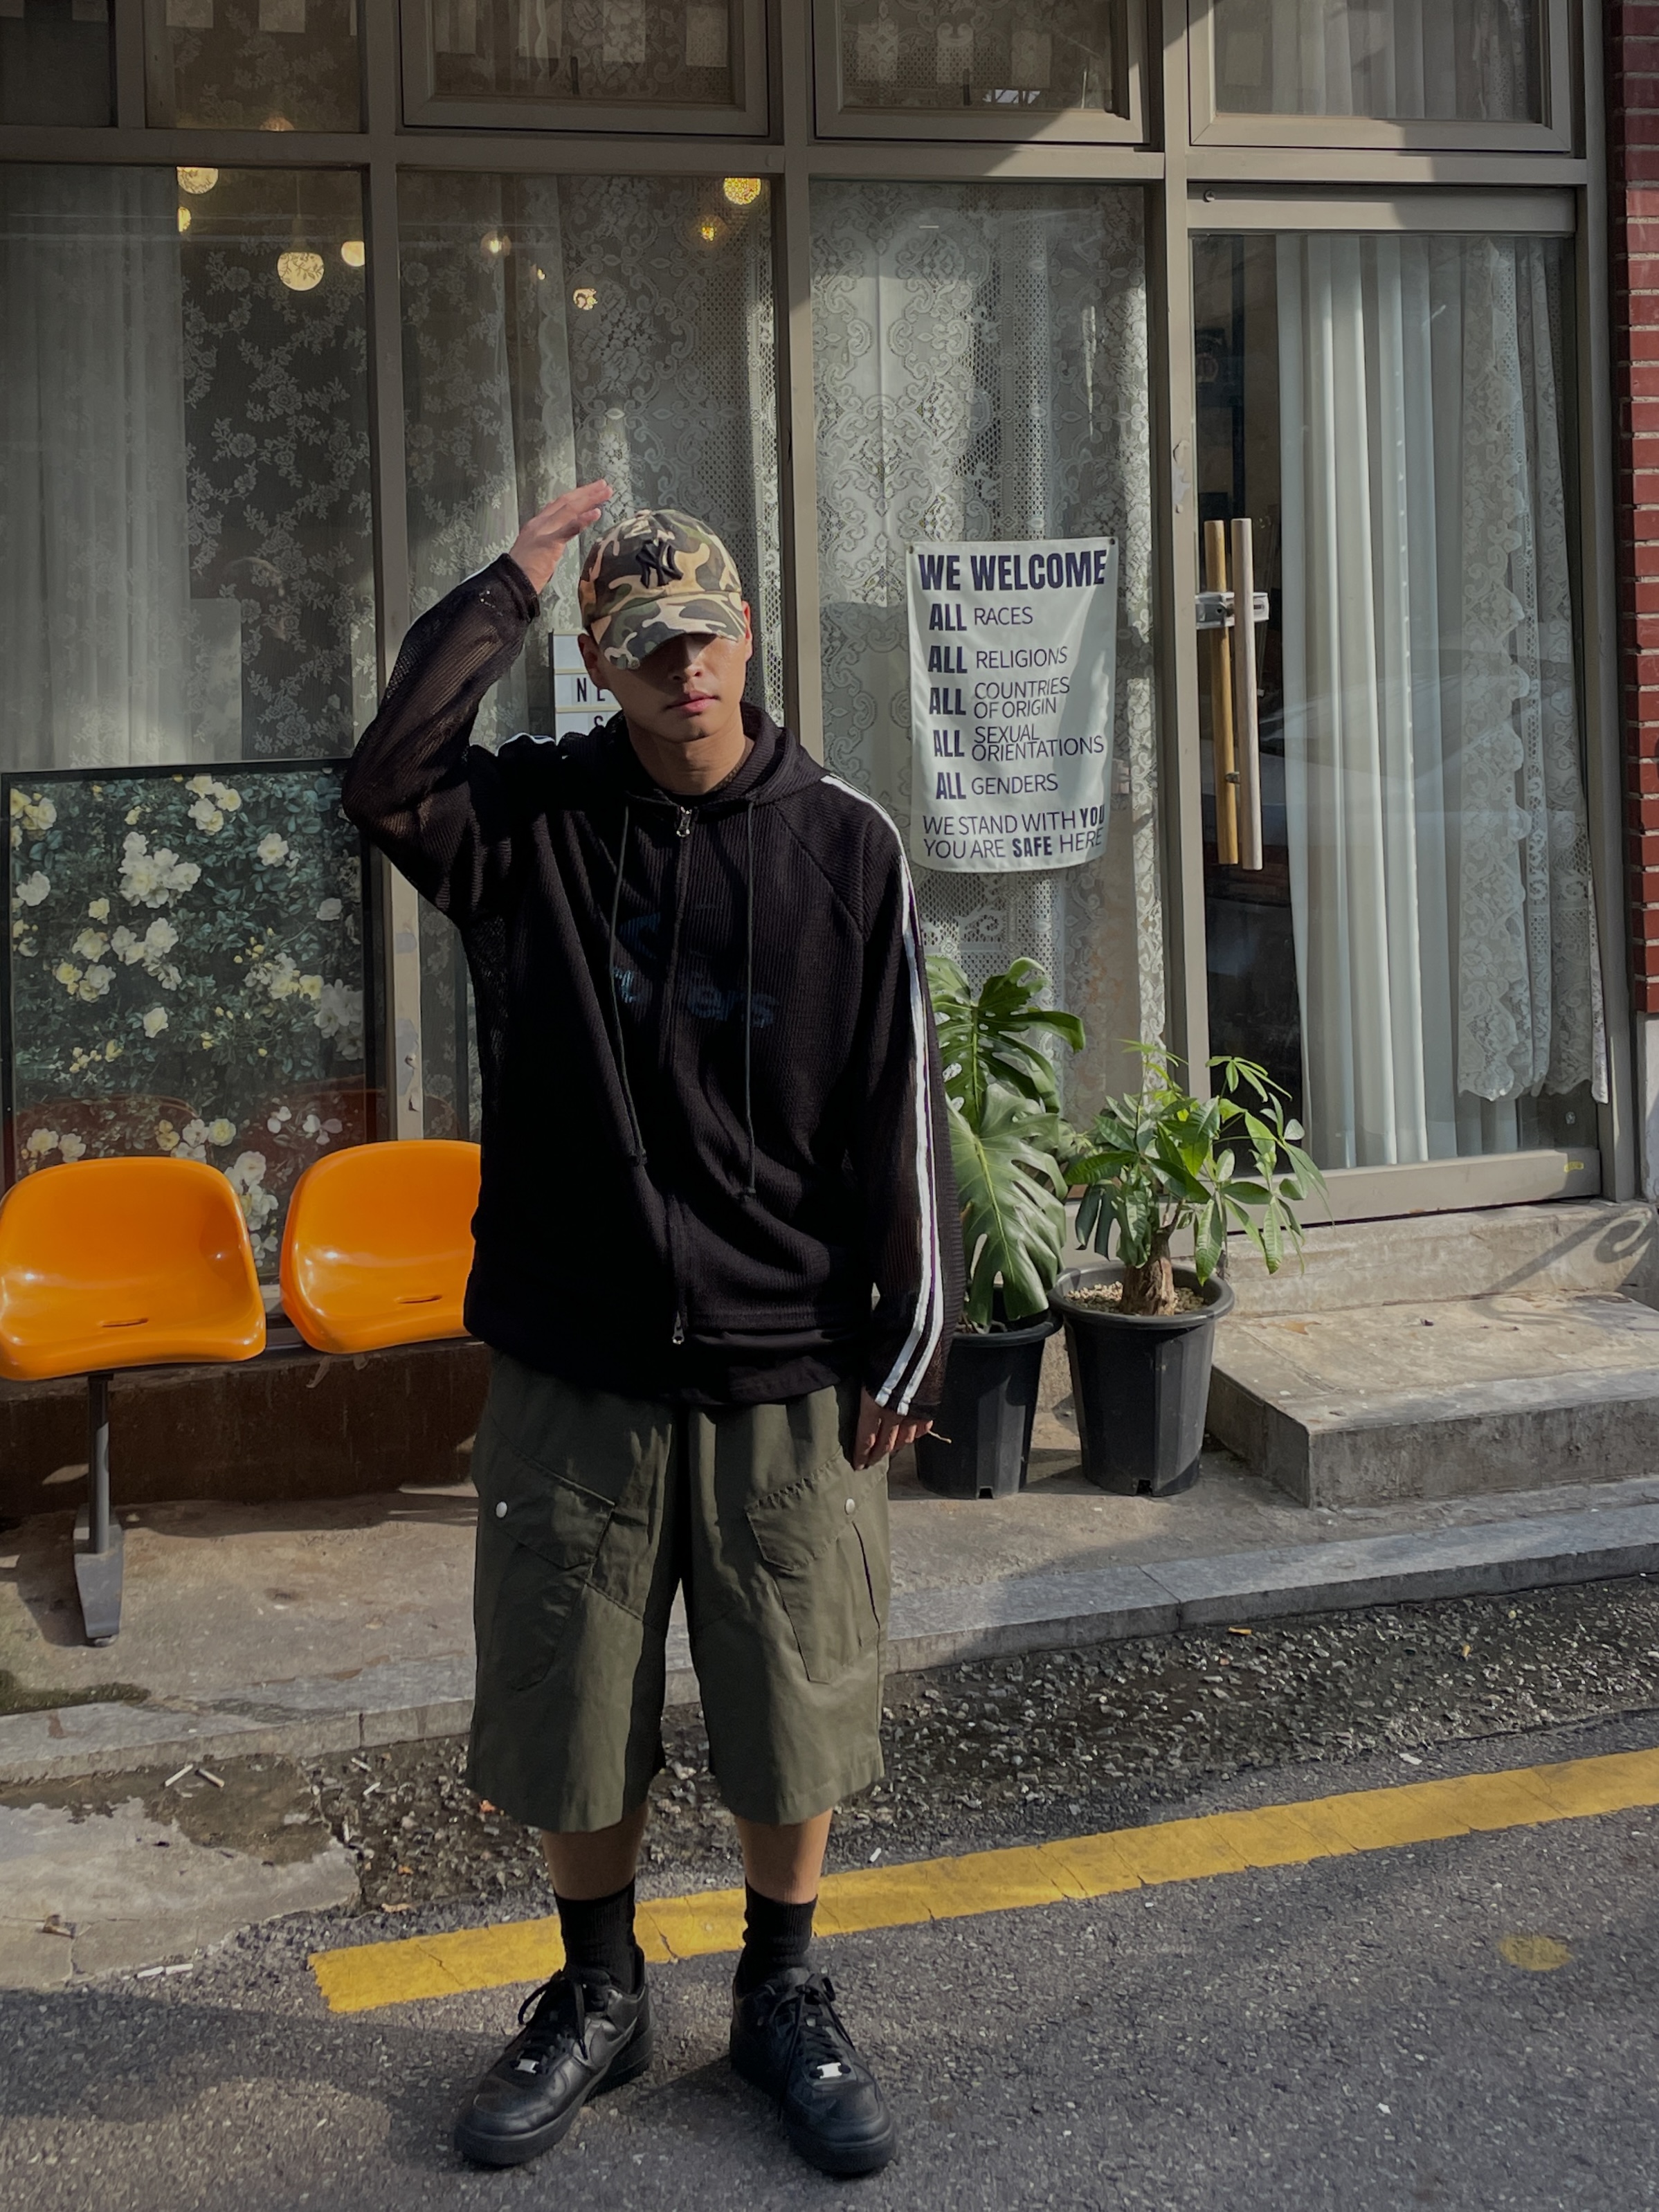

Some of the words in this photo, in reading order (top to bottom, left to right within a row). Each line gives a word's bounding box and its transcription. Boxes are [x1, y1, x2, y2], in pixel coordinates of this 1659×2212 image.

[635, 538, 684, 589] NY
[918, 554, 961, 590] WE
[970, 550, 1107, 591] WELCOME
[929, 604, 967, 631] ALL
[974, 606, 1033, 625] RACES
[928, 645, 968, 673] ALL
[976, 646, 1068, 669] RELIGIONS
[929, 687, 966, 715] ALL
[974, 676, 1070, 699] COUNTRIES
[974, 702, 999, 718] OF
[1002, 697, 1056, 718] ORIGIN
[933, 729, 965, 757] ALL
[974, 723, 1040, 743] SEXUAL
[972, 735, 1104, 761] ORIENTATIONS
[936, 772, 966, 799] ALL
[972, 773, 1058, 795] GENDERS
[923, 815, 954, 835] WE
[959, 815, 1017, 835] STAND
[1022, 810, 1076, 831] WITH
[1079, 804, 1105, 828] YOU
[924, 839, 966, 859] YOU
[970, 839, 1006, 858] ARE
[1012, 836, 1053, 858] SAFE
[1060, 827, 1104, 853] HERE
